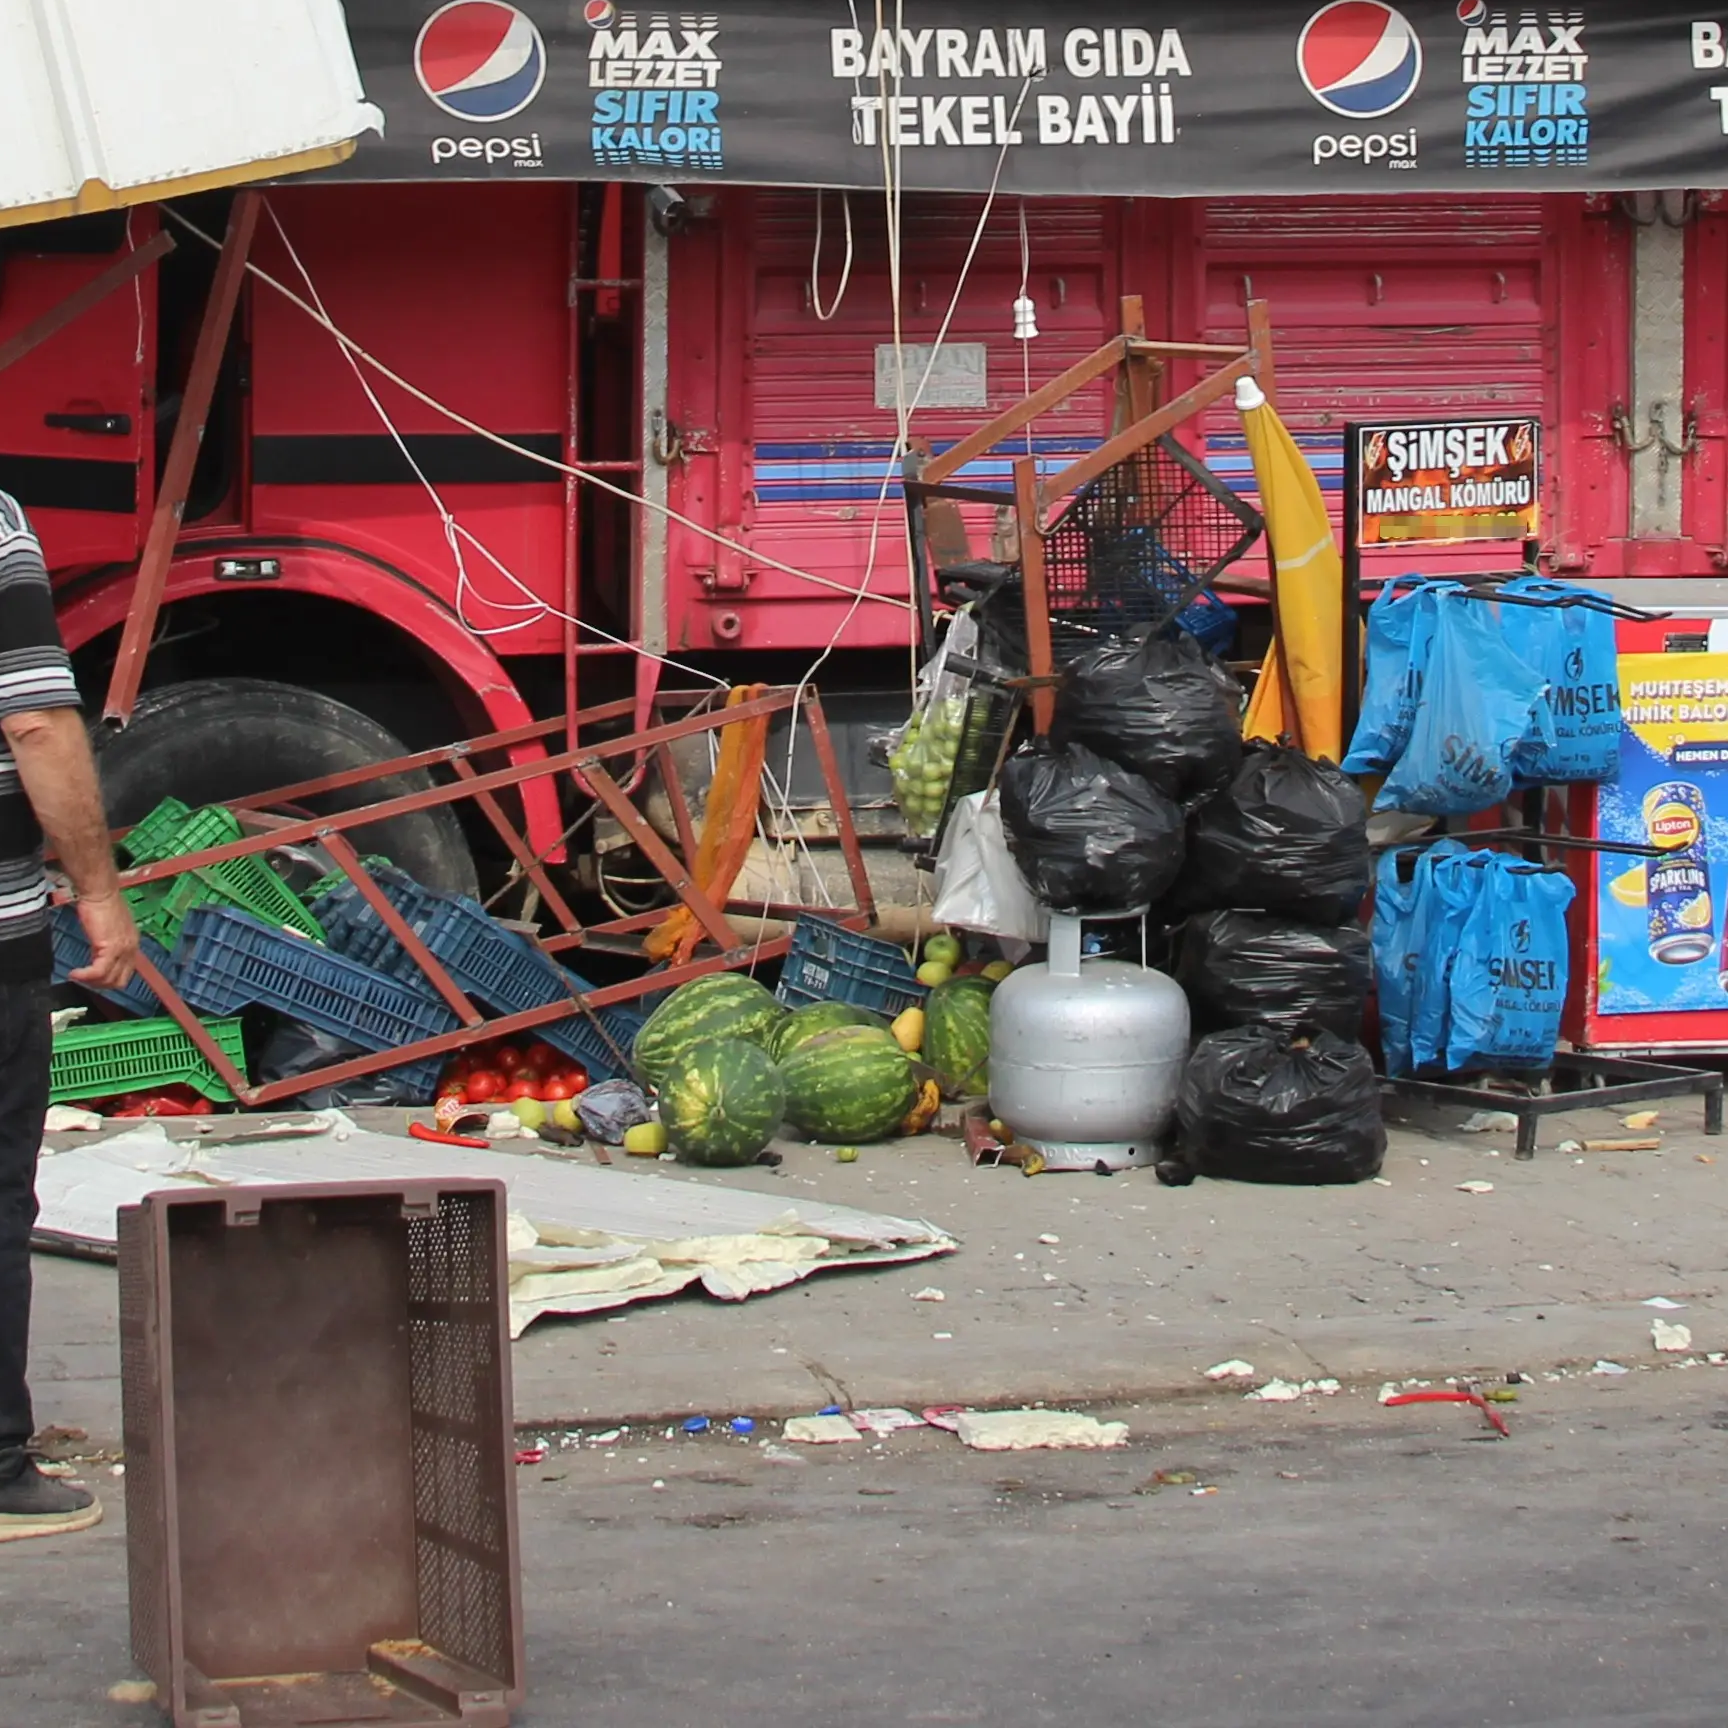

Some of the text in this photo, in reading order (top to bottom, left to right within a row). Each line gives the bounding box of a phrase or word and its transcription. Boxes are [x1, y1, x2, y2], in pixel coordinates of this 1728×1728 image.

[592, 29, 721, 59] MAX
[830, 27, 1192, 78] BAYRAM GIDA
[1462, 25, 1585, 55] MAX
[588, 58, 722, 88] LEZZET
[1462, 53, 1589, 83] LEZZET
[592, 89, 720, 124] SIFIR
[1466, 83, 1587, 118] SIFIR
[857, 95, 1030, 146] TEKEL
[430, 132, 543, 165] pepsi
[1313, 128, 1417, 165] pepsi
[514, 158, 543, 168] max
[1389, 158, 1417, 170] max
[1366, 476, 1530, 514] MANGAL KÖMÜRÜ
[1675, 749, 1719, 762] HEMEN
[1655, 820, 1692, 833] Lipton
